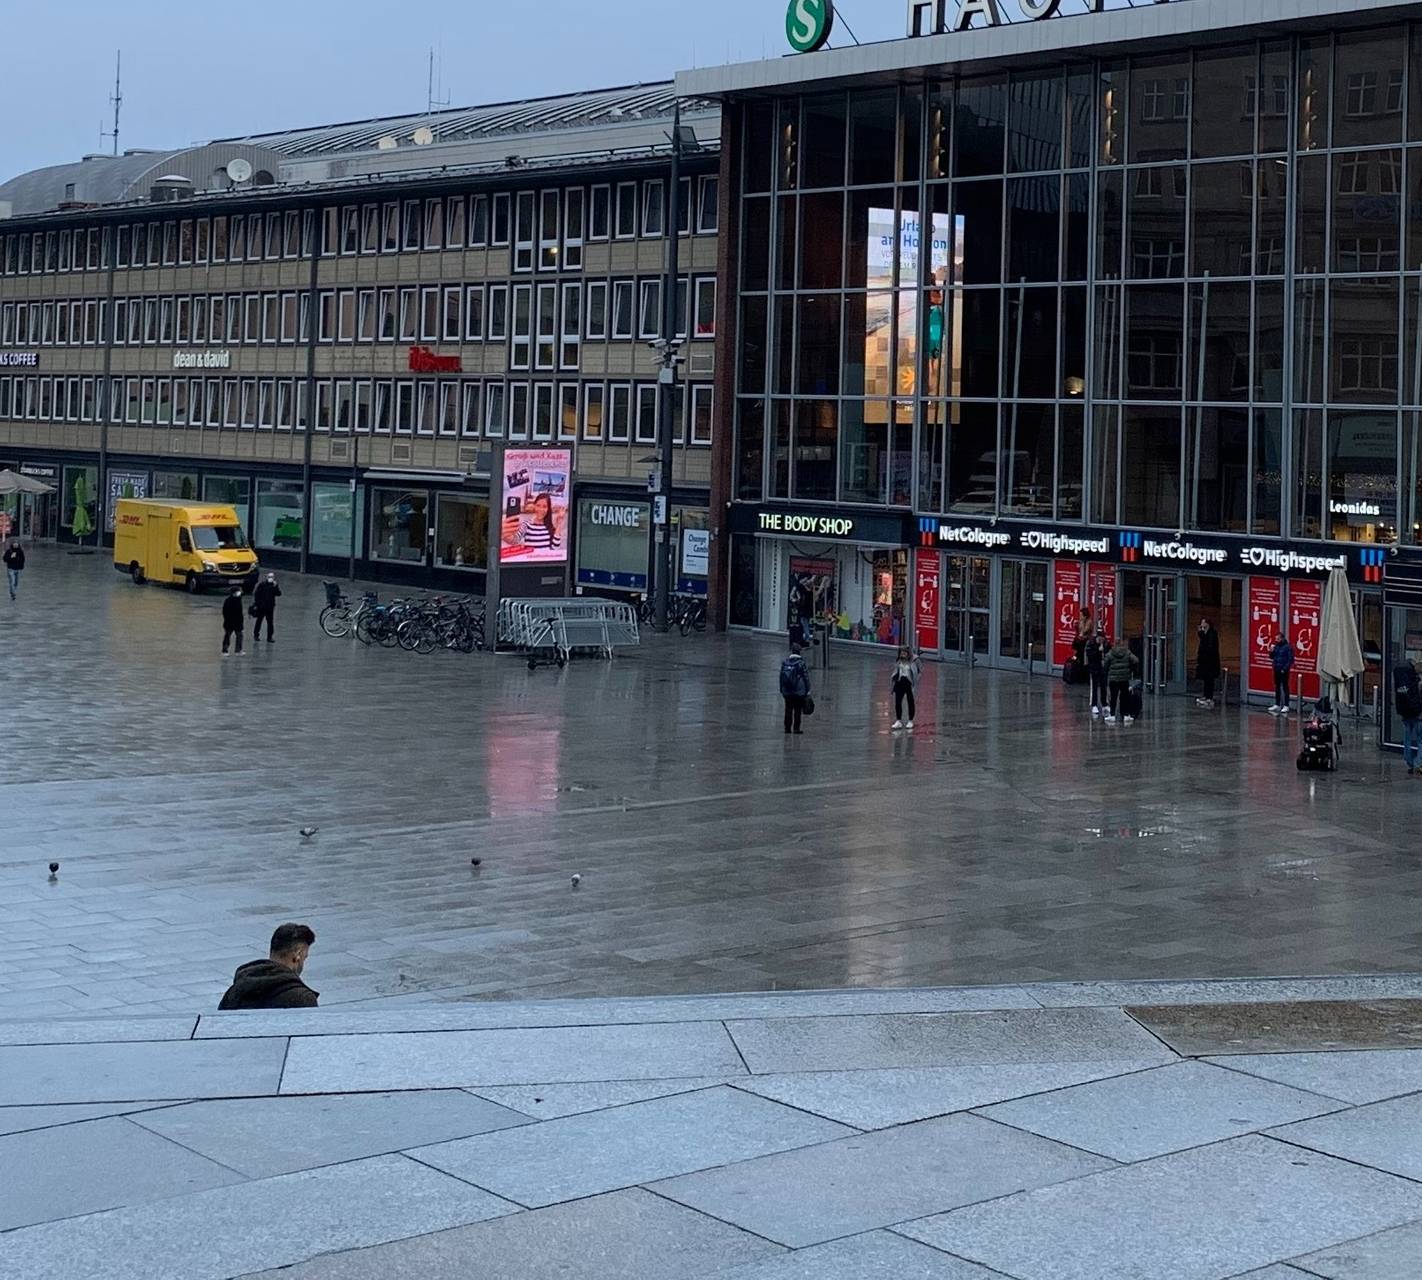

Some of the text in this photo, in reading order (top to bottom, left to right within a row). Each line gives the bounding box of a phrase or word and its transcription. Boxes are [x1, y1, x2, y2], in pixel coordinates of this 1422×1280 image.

[792, 0, 817, 43] S
[9, 353, 37, 365] COFFEE
[591, 505, 640, 527] CHANGE
[1329, 500, 1380, 516] Leonidas
[759, 513, 853, 535] THE BODY SHOP
[939, 525, 1108, 554] NetCologne Highspeed
[1143, 540, 1345, 573] NetCologne Highspeed
